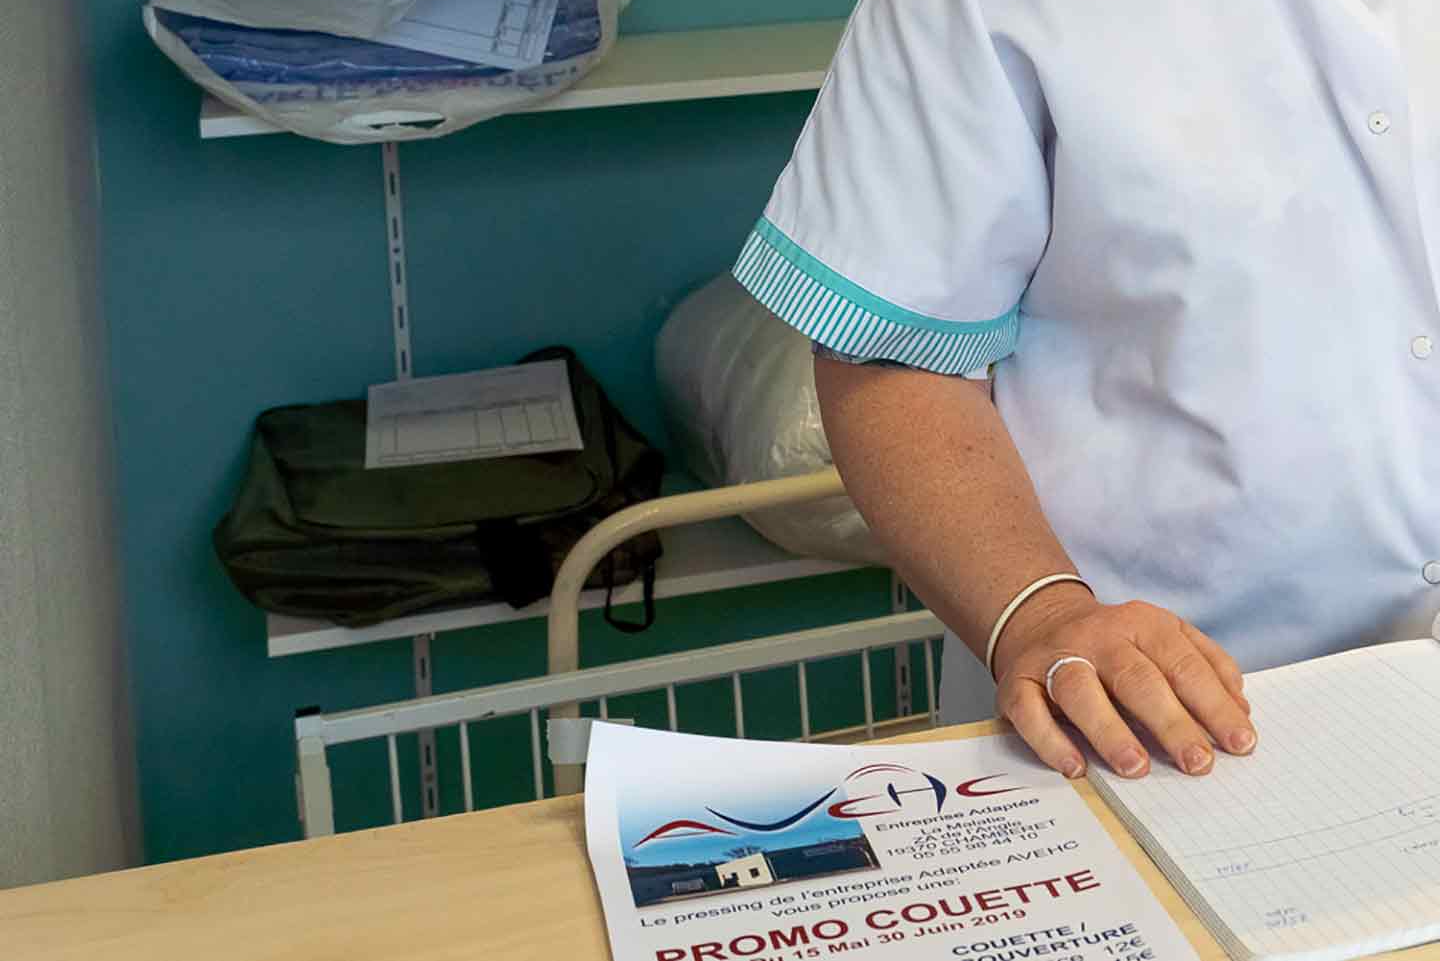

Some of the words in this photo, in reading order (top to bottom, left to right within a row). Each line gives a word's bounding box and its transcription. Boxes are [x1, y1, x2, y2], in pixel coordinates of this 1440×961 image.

[875, 812, 965, 832] Entreprise
[969, 798, 1040, 817] Adaptée
[887, 842, 937, 857] 19370
[942, 819, 1057, 847] CHAMBERET
[1020, 833, 1039, 841] 10
[640, 916, 667, 928] Le
[674, 900, 764, 924] pressing
[769, 890, 795, 907] de
[800, 874, 913, 900] l'entreprise
[918, 856, 1001, 879] Adaptée
[1006, 841, 1081, 864] AVEHC
[771, 902, 822, 918] vous
[828, 886, 911, 909] propose
[656, 919, 849, 961] PROMO
[865, 869, 1102, 931] COUETTE
[792, 946, 821, 960] 15
[828, 939, 871, 955] Mai
[878, 931, 905, 947] 30
[913, 921, 964, 938] Juin
[971, 909, 1027, 927] 2019
[952, 925, 1075, 957] COUETTE
[962, 922, 1140, 961] OUVERTURE
[1104, 935, 1146, 956] 12€
